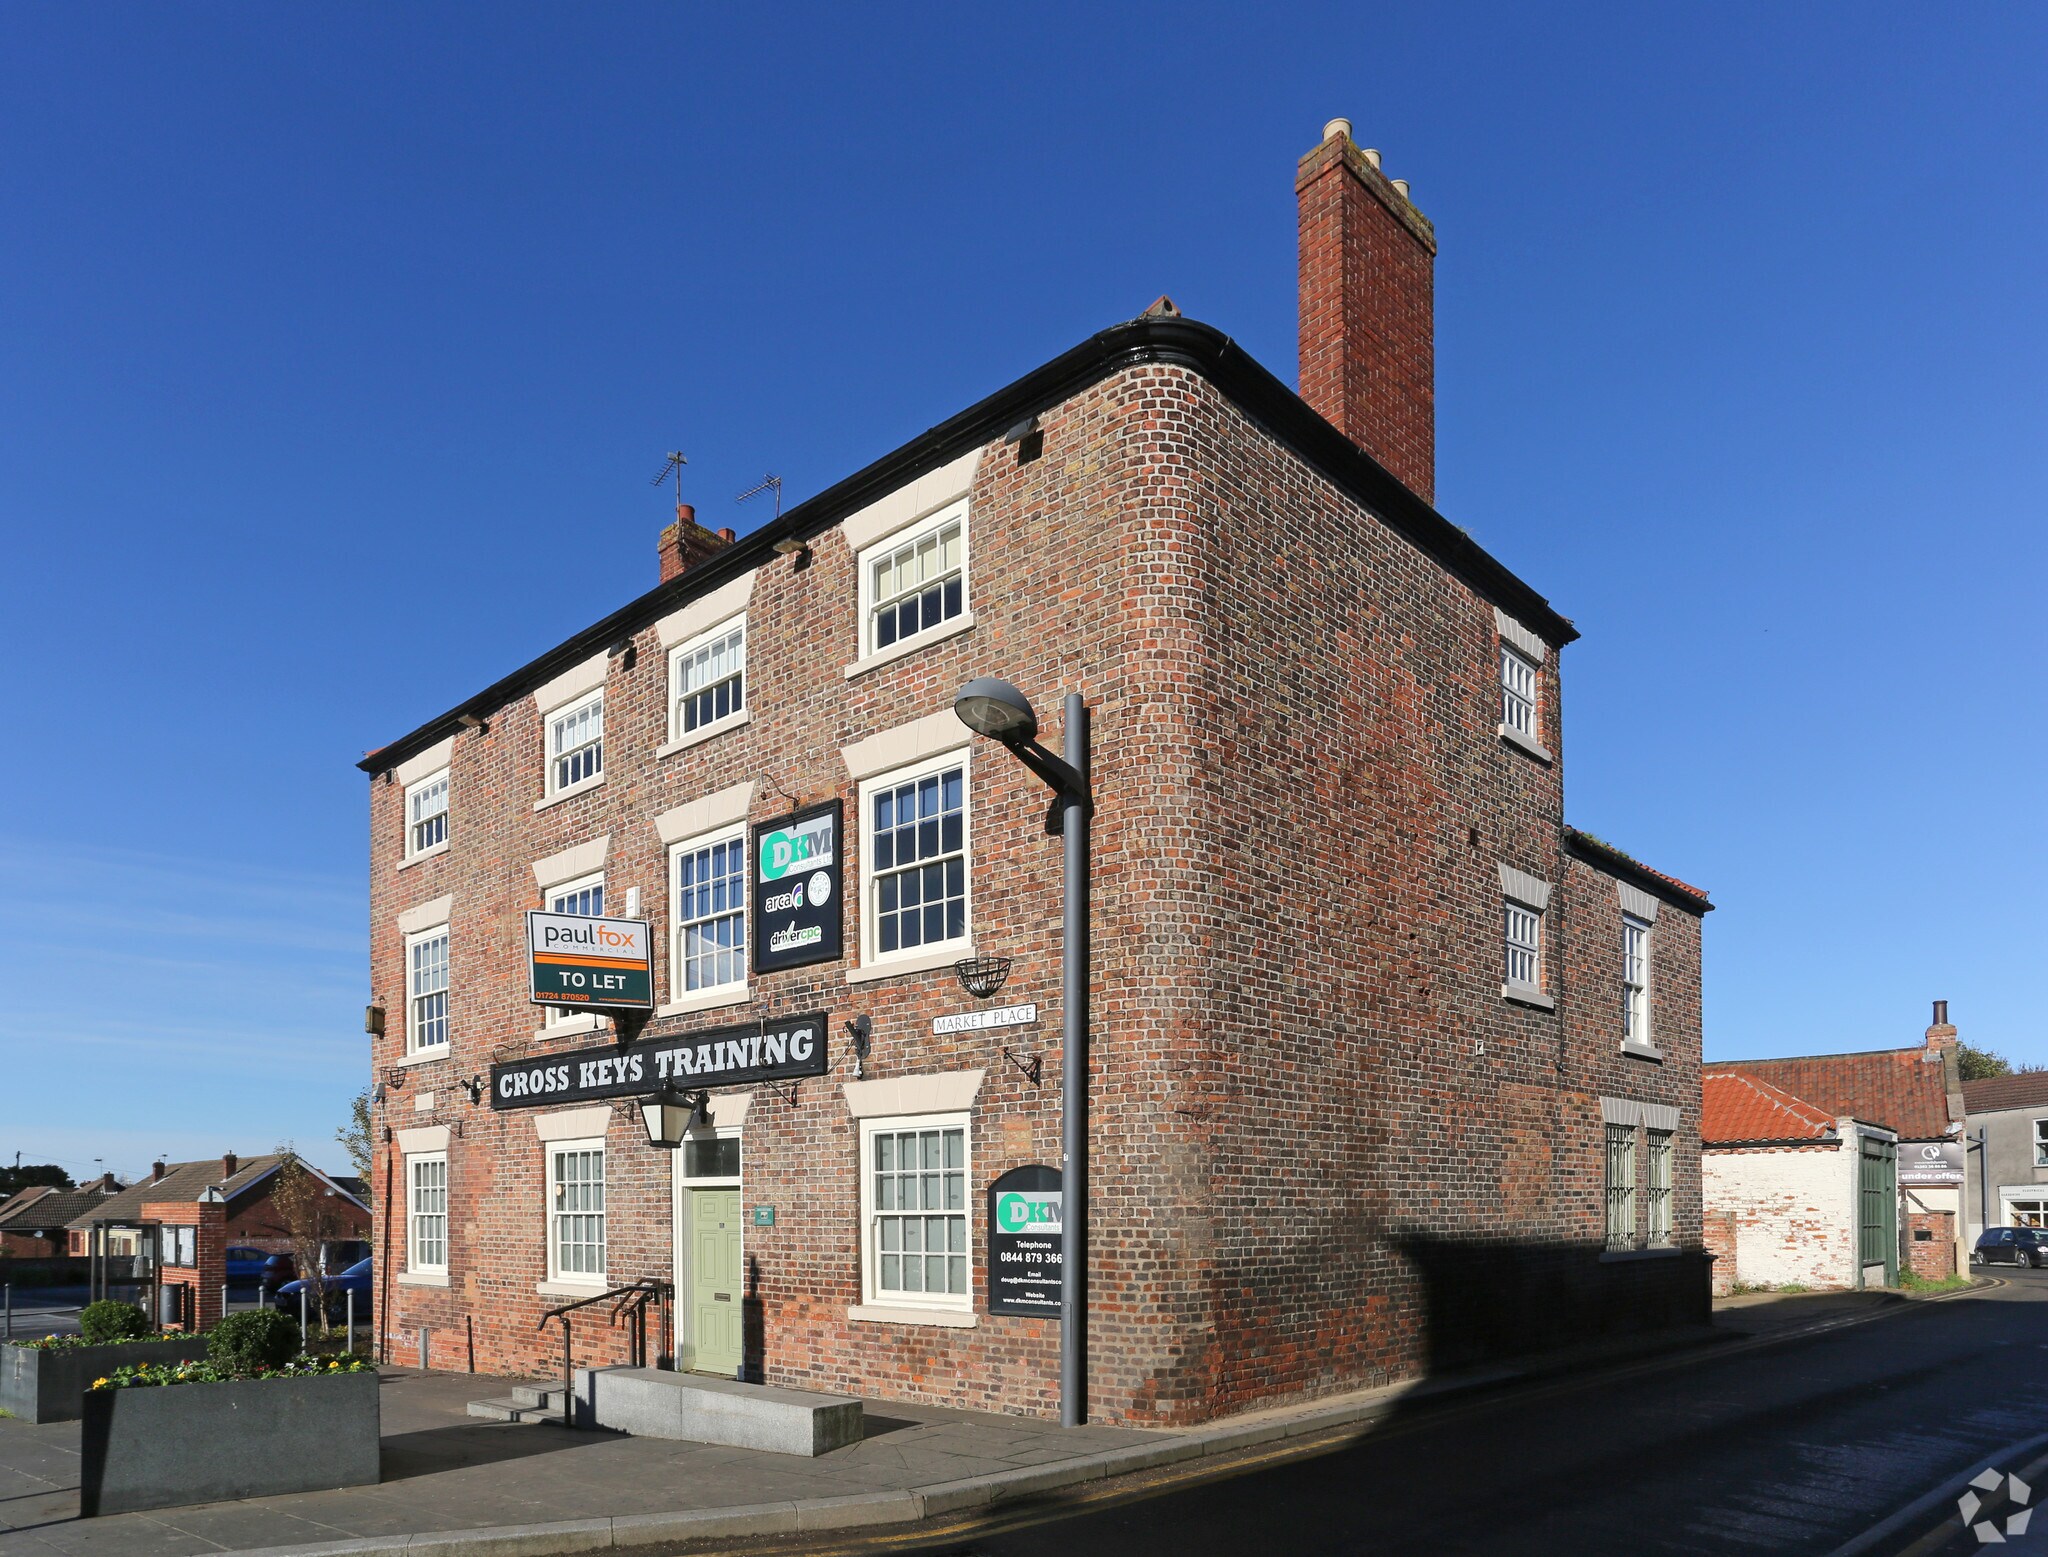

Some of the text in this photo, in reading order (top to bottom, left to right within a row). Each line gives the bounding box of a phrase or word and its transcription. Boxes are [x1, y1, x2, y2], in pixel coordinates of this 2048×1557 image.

[773, 827, 831, 868] DKM
[554, 944, 635, 954] COMMERCIAL
[559, 971, 626, 989] TO LET
[535, 991, 558, 1000] 01724
[561, 992, 589, 1001] 870520
[936, 1007, 1032, 1032] MARKET PLACE
[499, 1028, 814, 1098] CROSS KEYS TRAINING
[1902, 1172, 1960, 1180] under offer
[1026, 1223, 1060, 1232] Consultants
[1016, 1240, 1052, 1250] Telephone
[1000, 1251, 1062, 1264] 0844 879 366
